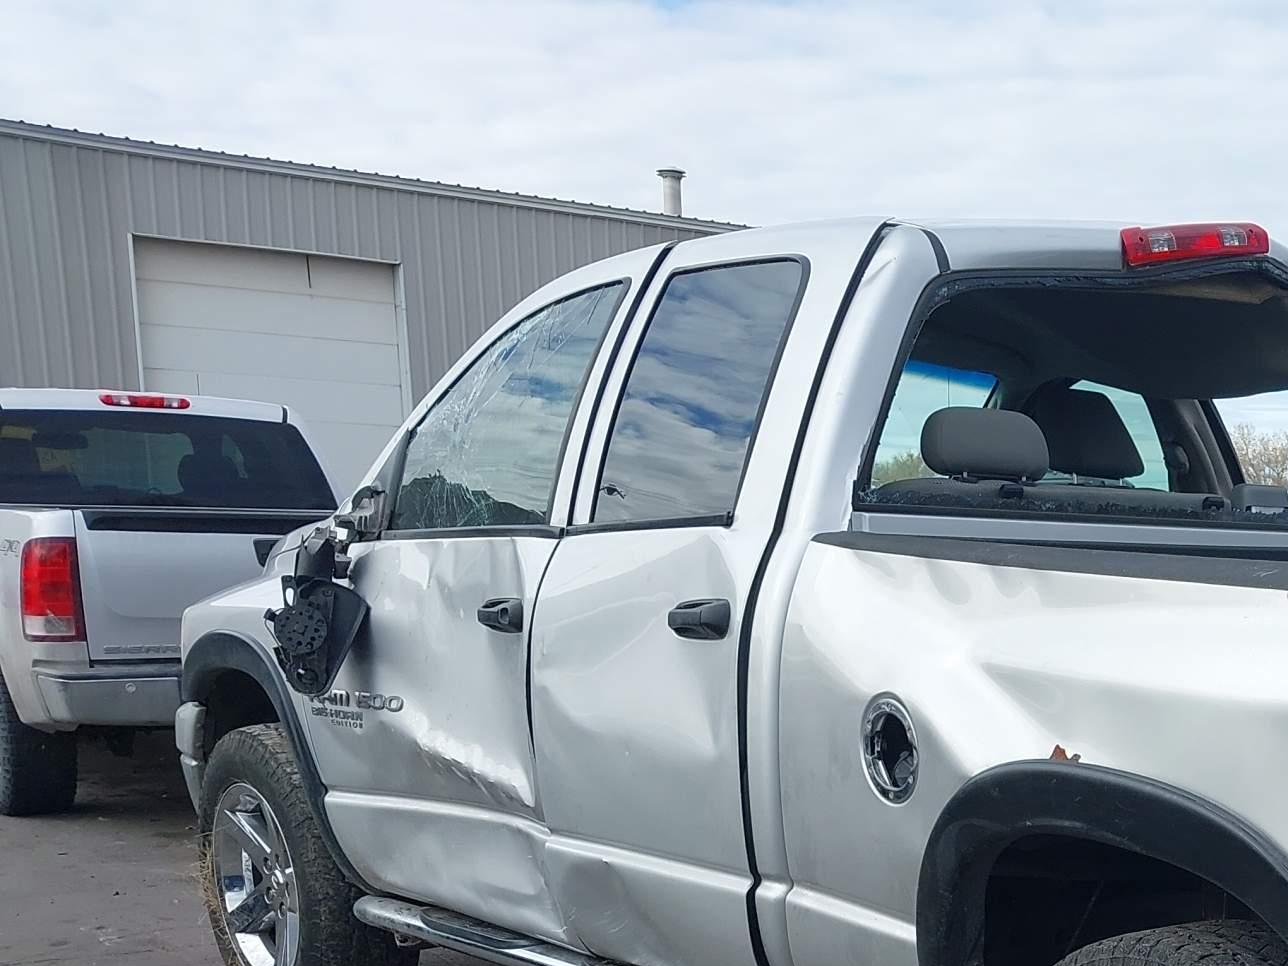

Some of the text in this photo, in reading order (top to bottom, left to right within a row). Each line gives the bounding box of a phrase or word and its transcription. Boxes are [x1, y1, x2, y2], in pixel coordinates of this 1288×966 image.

[103, 643, 182, 655] SIERR
[354, 690, 405, 713] 1500
[329, 708, 364, 722] HORN
